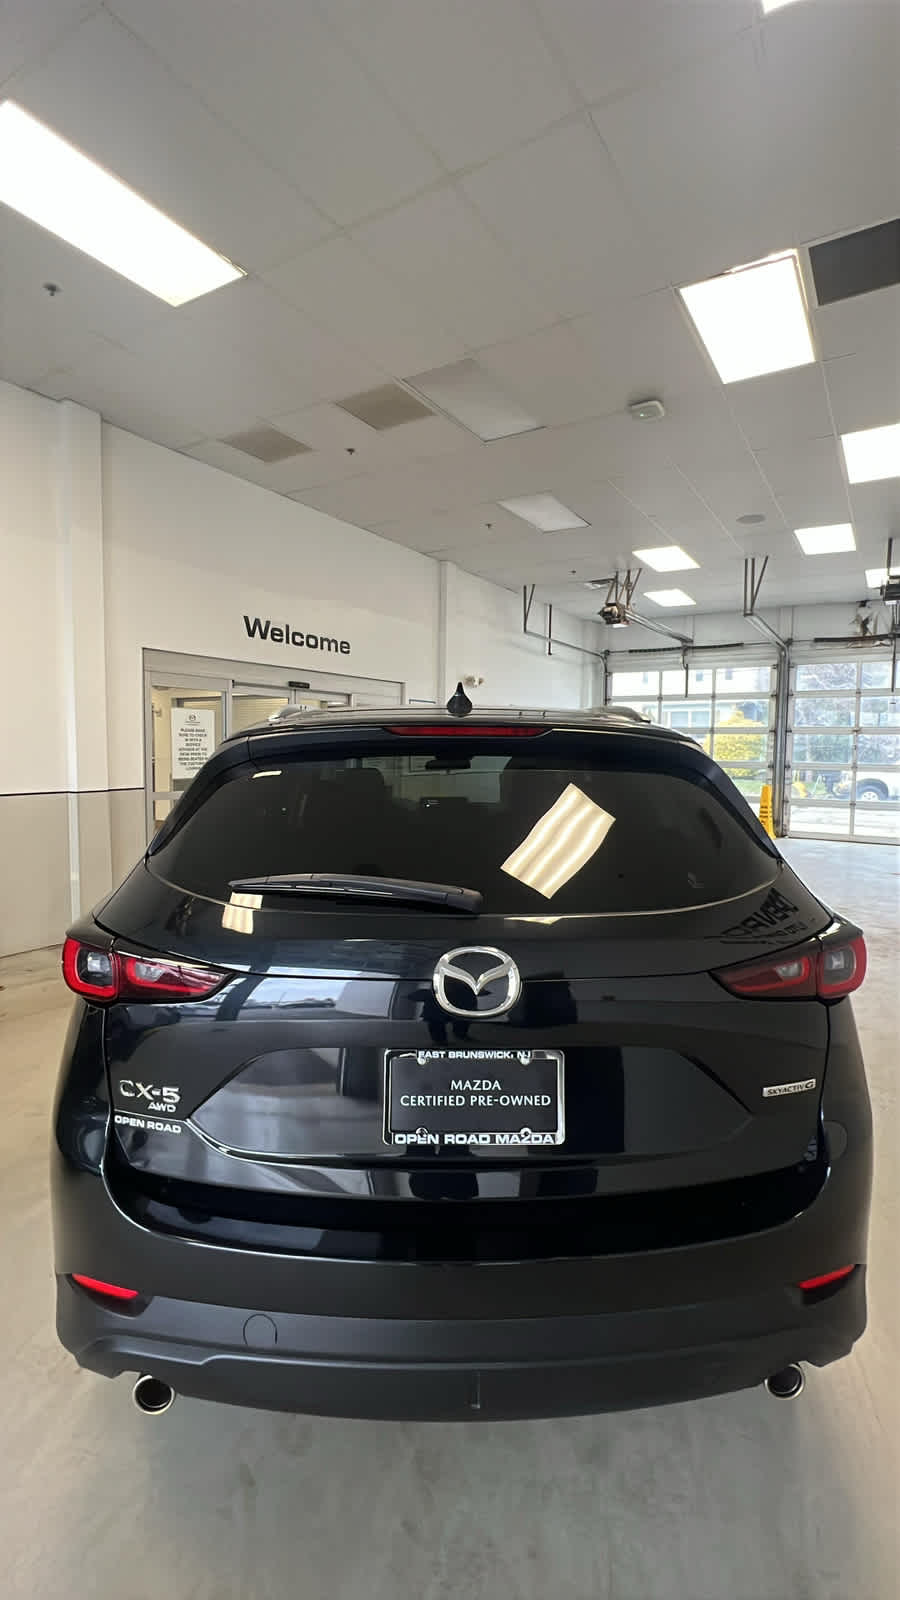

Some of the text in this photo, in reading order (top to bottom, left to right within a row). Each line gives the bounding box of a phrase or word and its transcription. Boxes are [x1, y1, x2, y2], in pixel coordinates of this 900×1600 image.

[243, 615, 351, 655] Welcome
[418, 1050, 531, 1060] EAST BRUNSWICK, NJ
[450, 1080, 502, 1091] MAZDA
[120, 1080, 181, 1104] CX-5
[400, 1095, 551, 1107] CERTIFIED PRE-OWNED
[148, 1102, 176, 1113] AWD
[114, 1115, 182, 1134] OPEN ROAD
[394, 1133, 555, 1144] OPEN ROAD MAZDA
